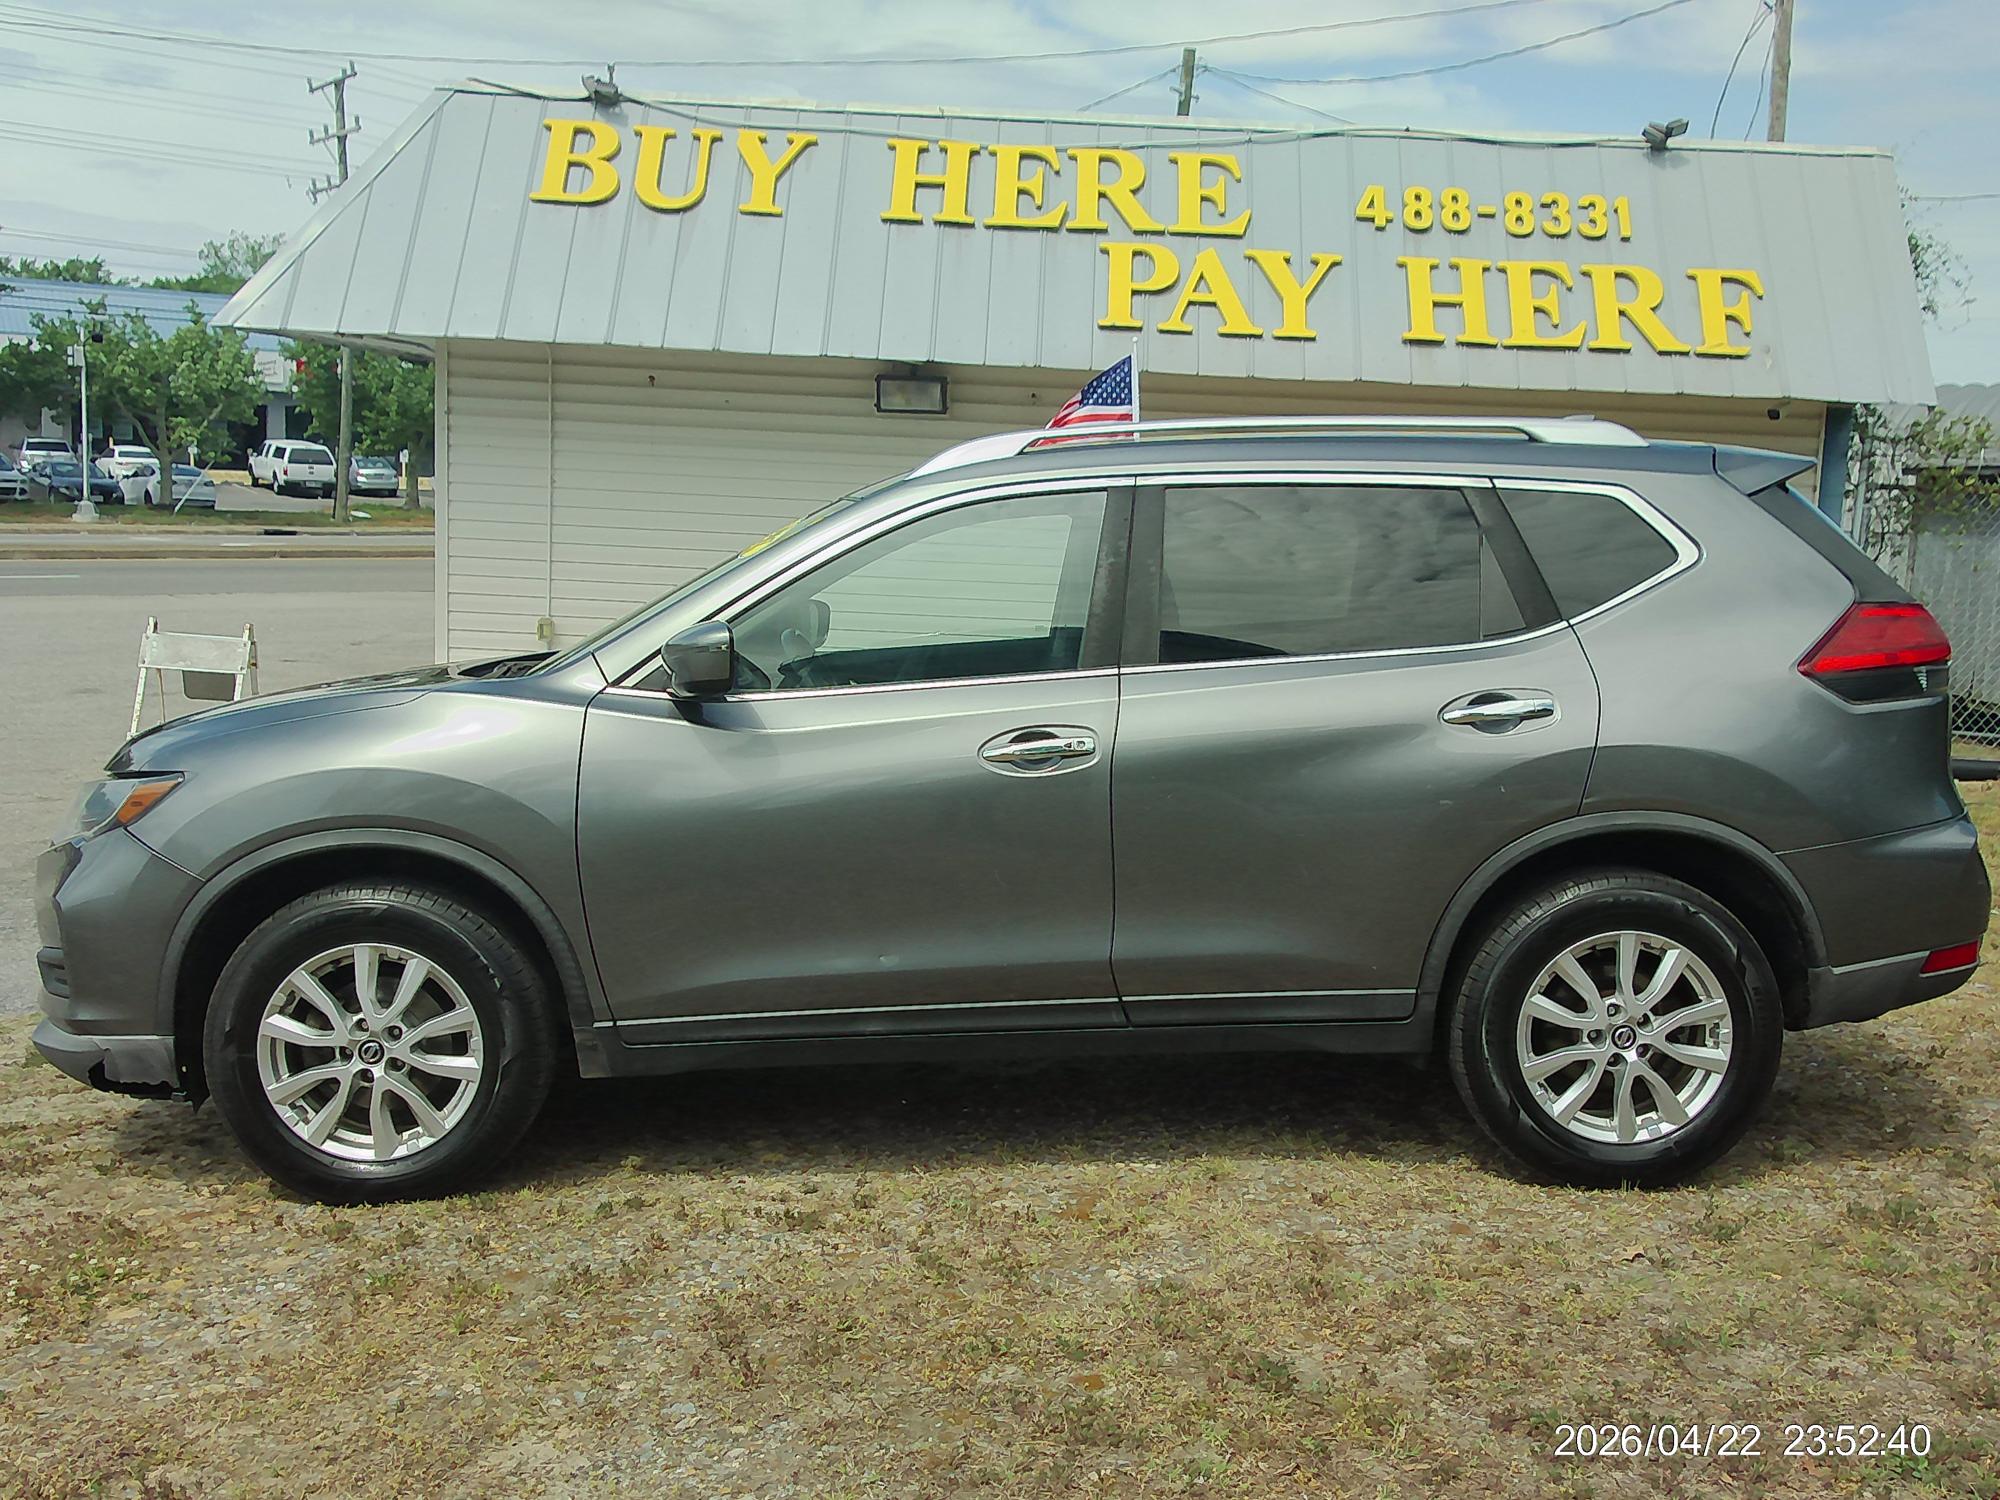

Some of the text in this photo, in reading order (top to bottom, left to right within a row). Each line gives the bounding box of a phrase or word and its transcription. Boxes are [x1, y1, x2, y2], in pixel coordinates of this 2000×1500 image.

[529, 119, 1253, 237] BUY HERE
[1355, 185, 1633, 240] 488-8331
[1098, 242, 1342, 339] PAY
